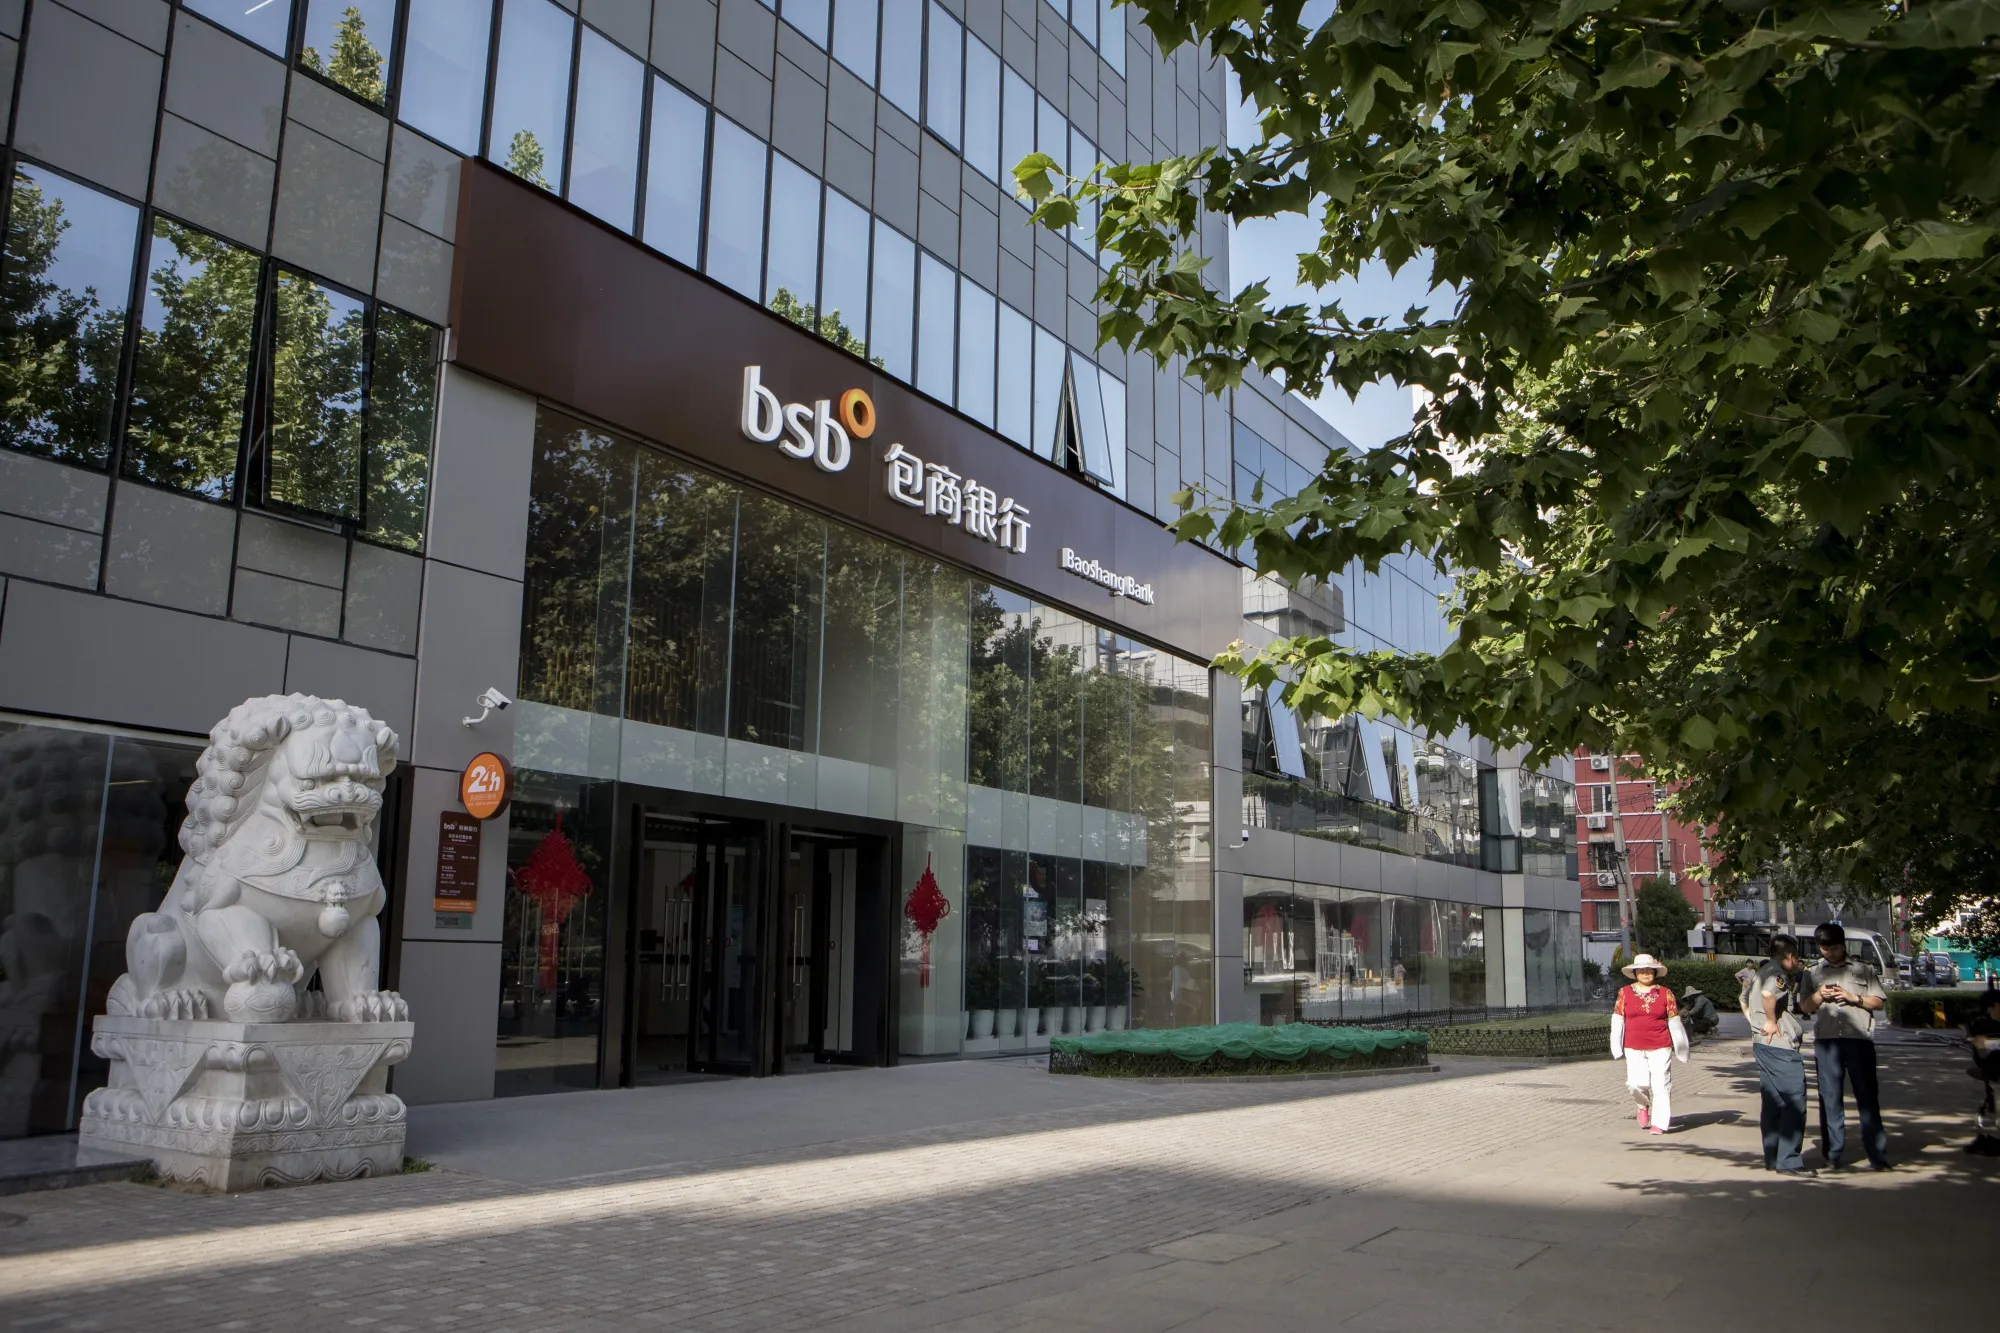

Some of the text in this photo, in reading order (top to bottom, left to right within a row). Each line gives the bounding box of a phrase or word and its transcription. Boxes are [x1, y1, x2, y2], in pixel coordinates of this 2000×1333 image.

[884, 443, 1031, 554] 包商银行
[1059, 547, 1155, 606] Baoshang Bank
[467, 764, 501, 793] 24h
